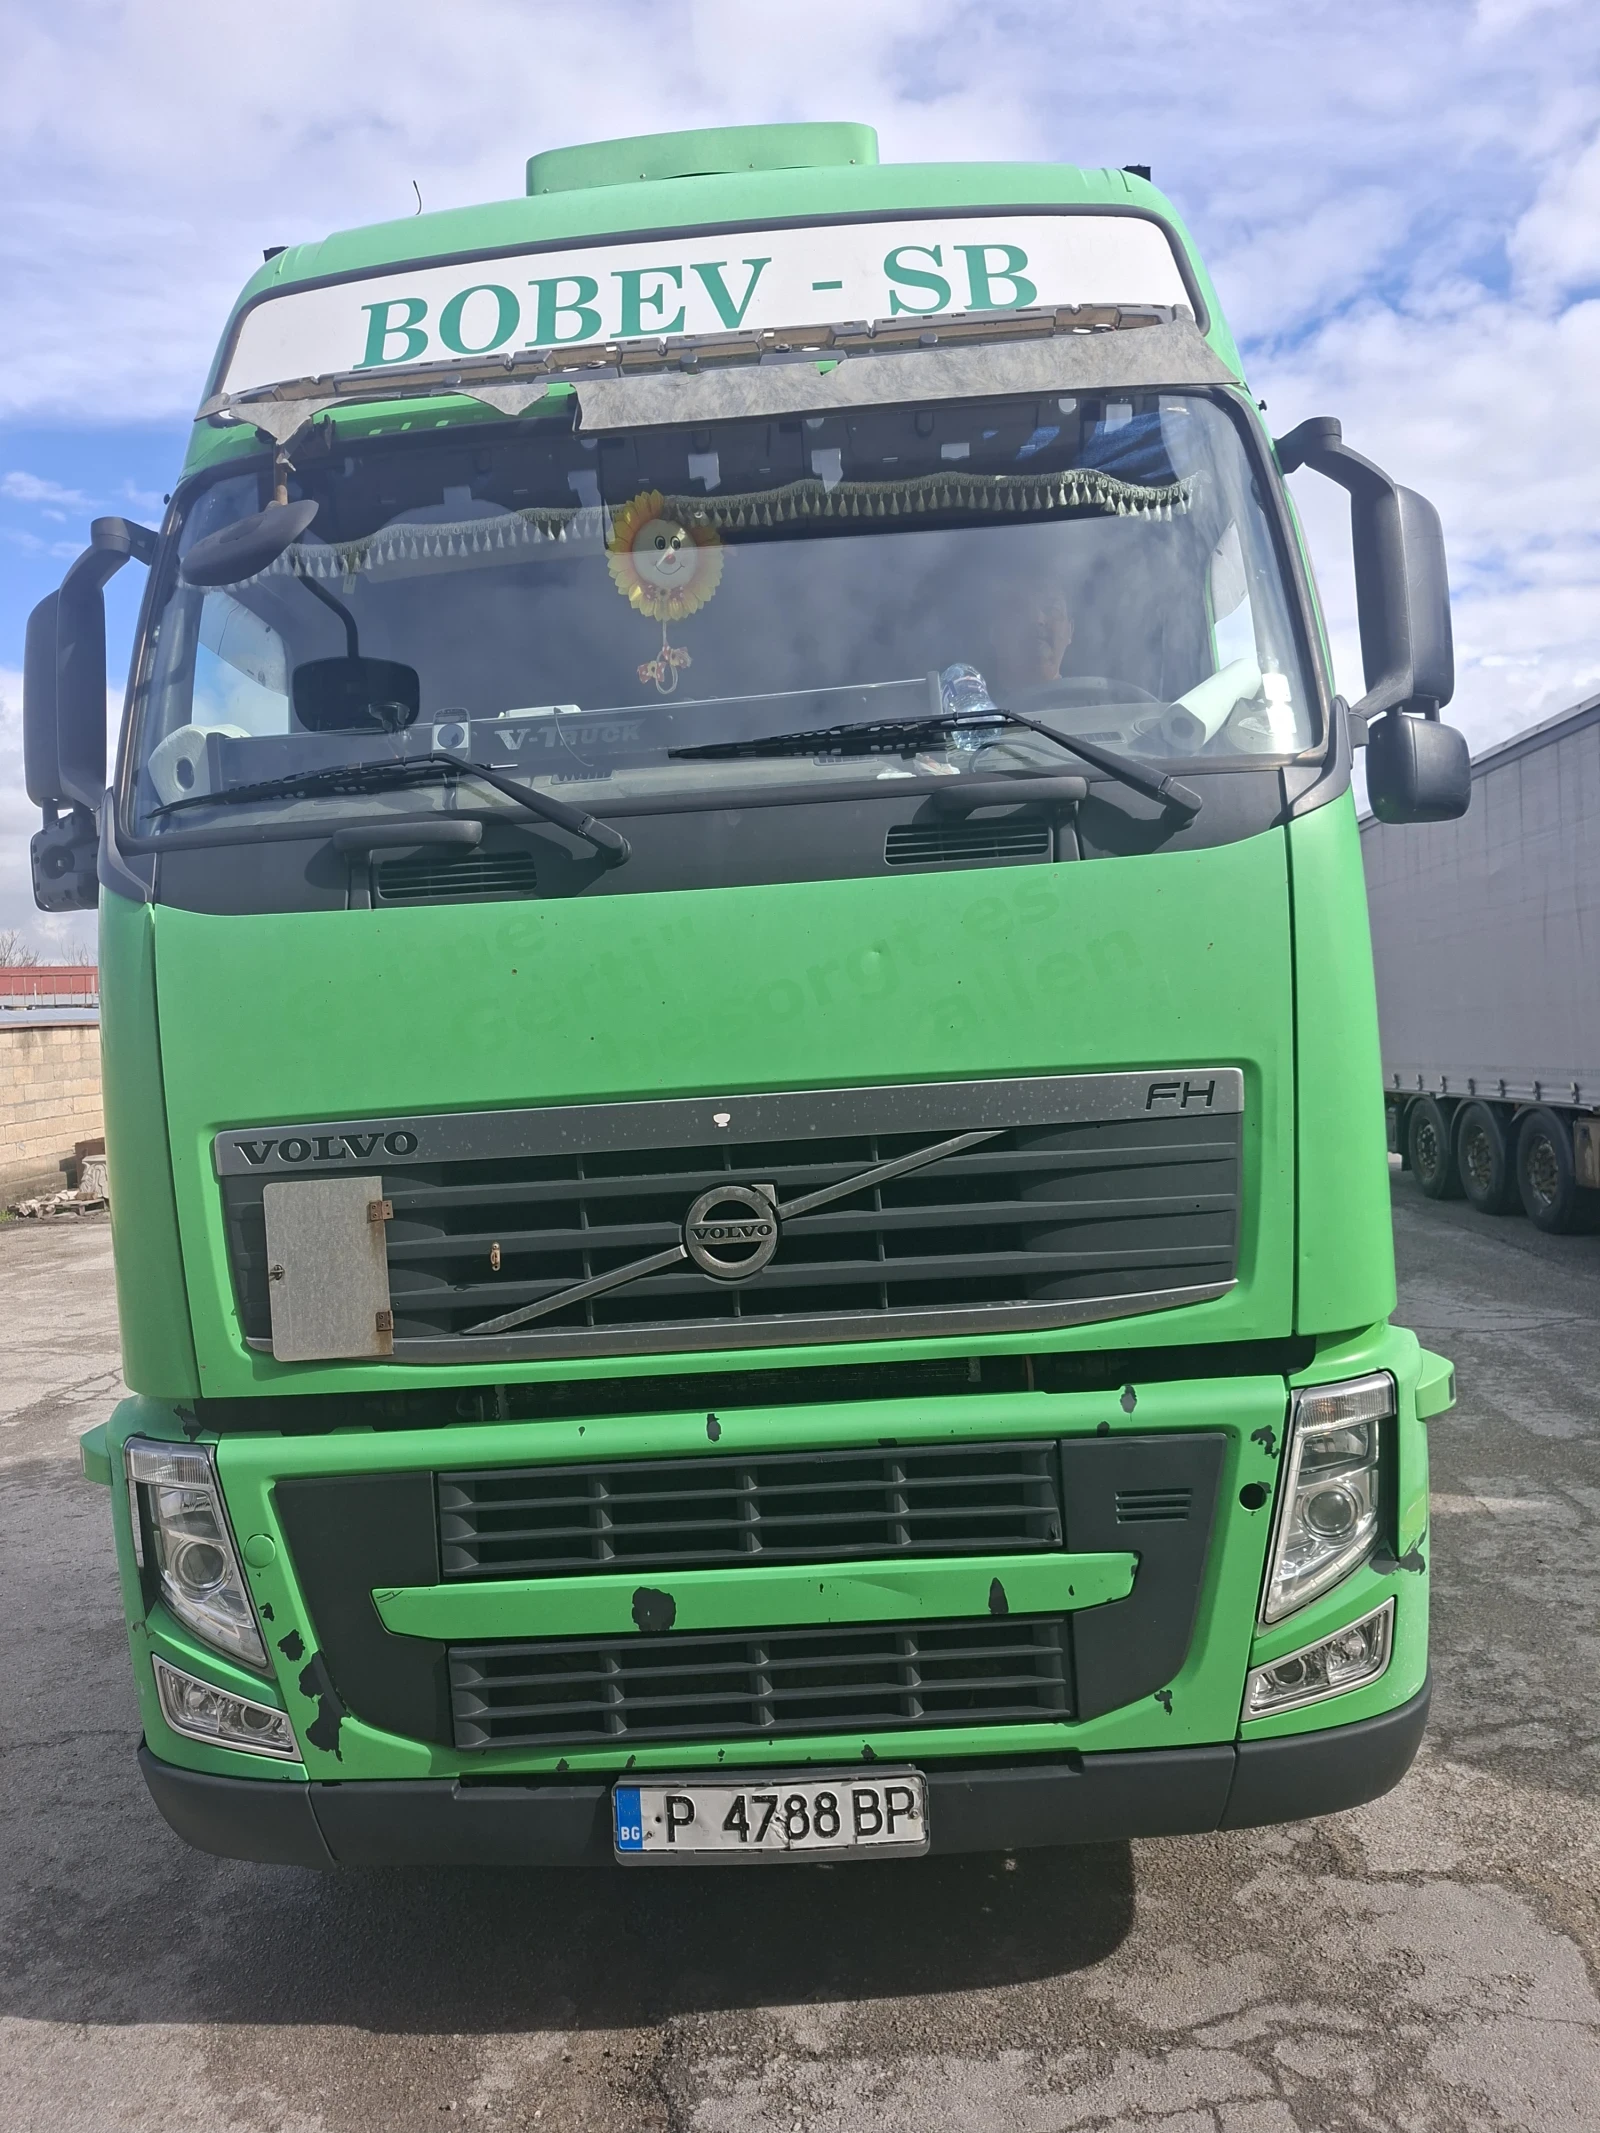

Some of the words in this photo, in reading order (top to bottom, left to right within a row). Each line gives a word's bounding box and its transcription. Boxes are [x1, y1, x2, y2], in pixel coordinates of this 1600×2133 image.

[353, 257, 772, 370] BOBEV
[812, 280, 843, 291] -
[883, 244, 1038, 316] SB
[494, 718, 647, 751] V-TRUCK
[1145, 1080, 1215, 1111] FH
[233, 1131, 418, 1166] VOLVO
[690, 1224, 773, 1241] VOLVO
[664, 1795, 695, 1843] P
[722, 1791, 841, 1843] 4788
[852, 1786, 915, 1837] BP
[620, 1826, 640, 1841] BG
